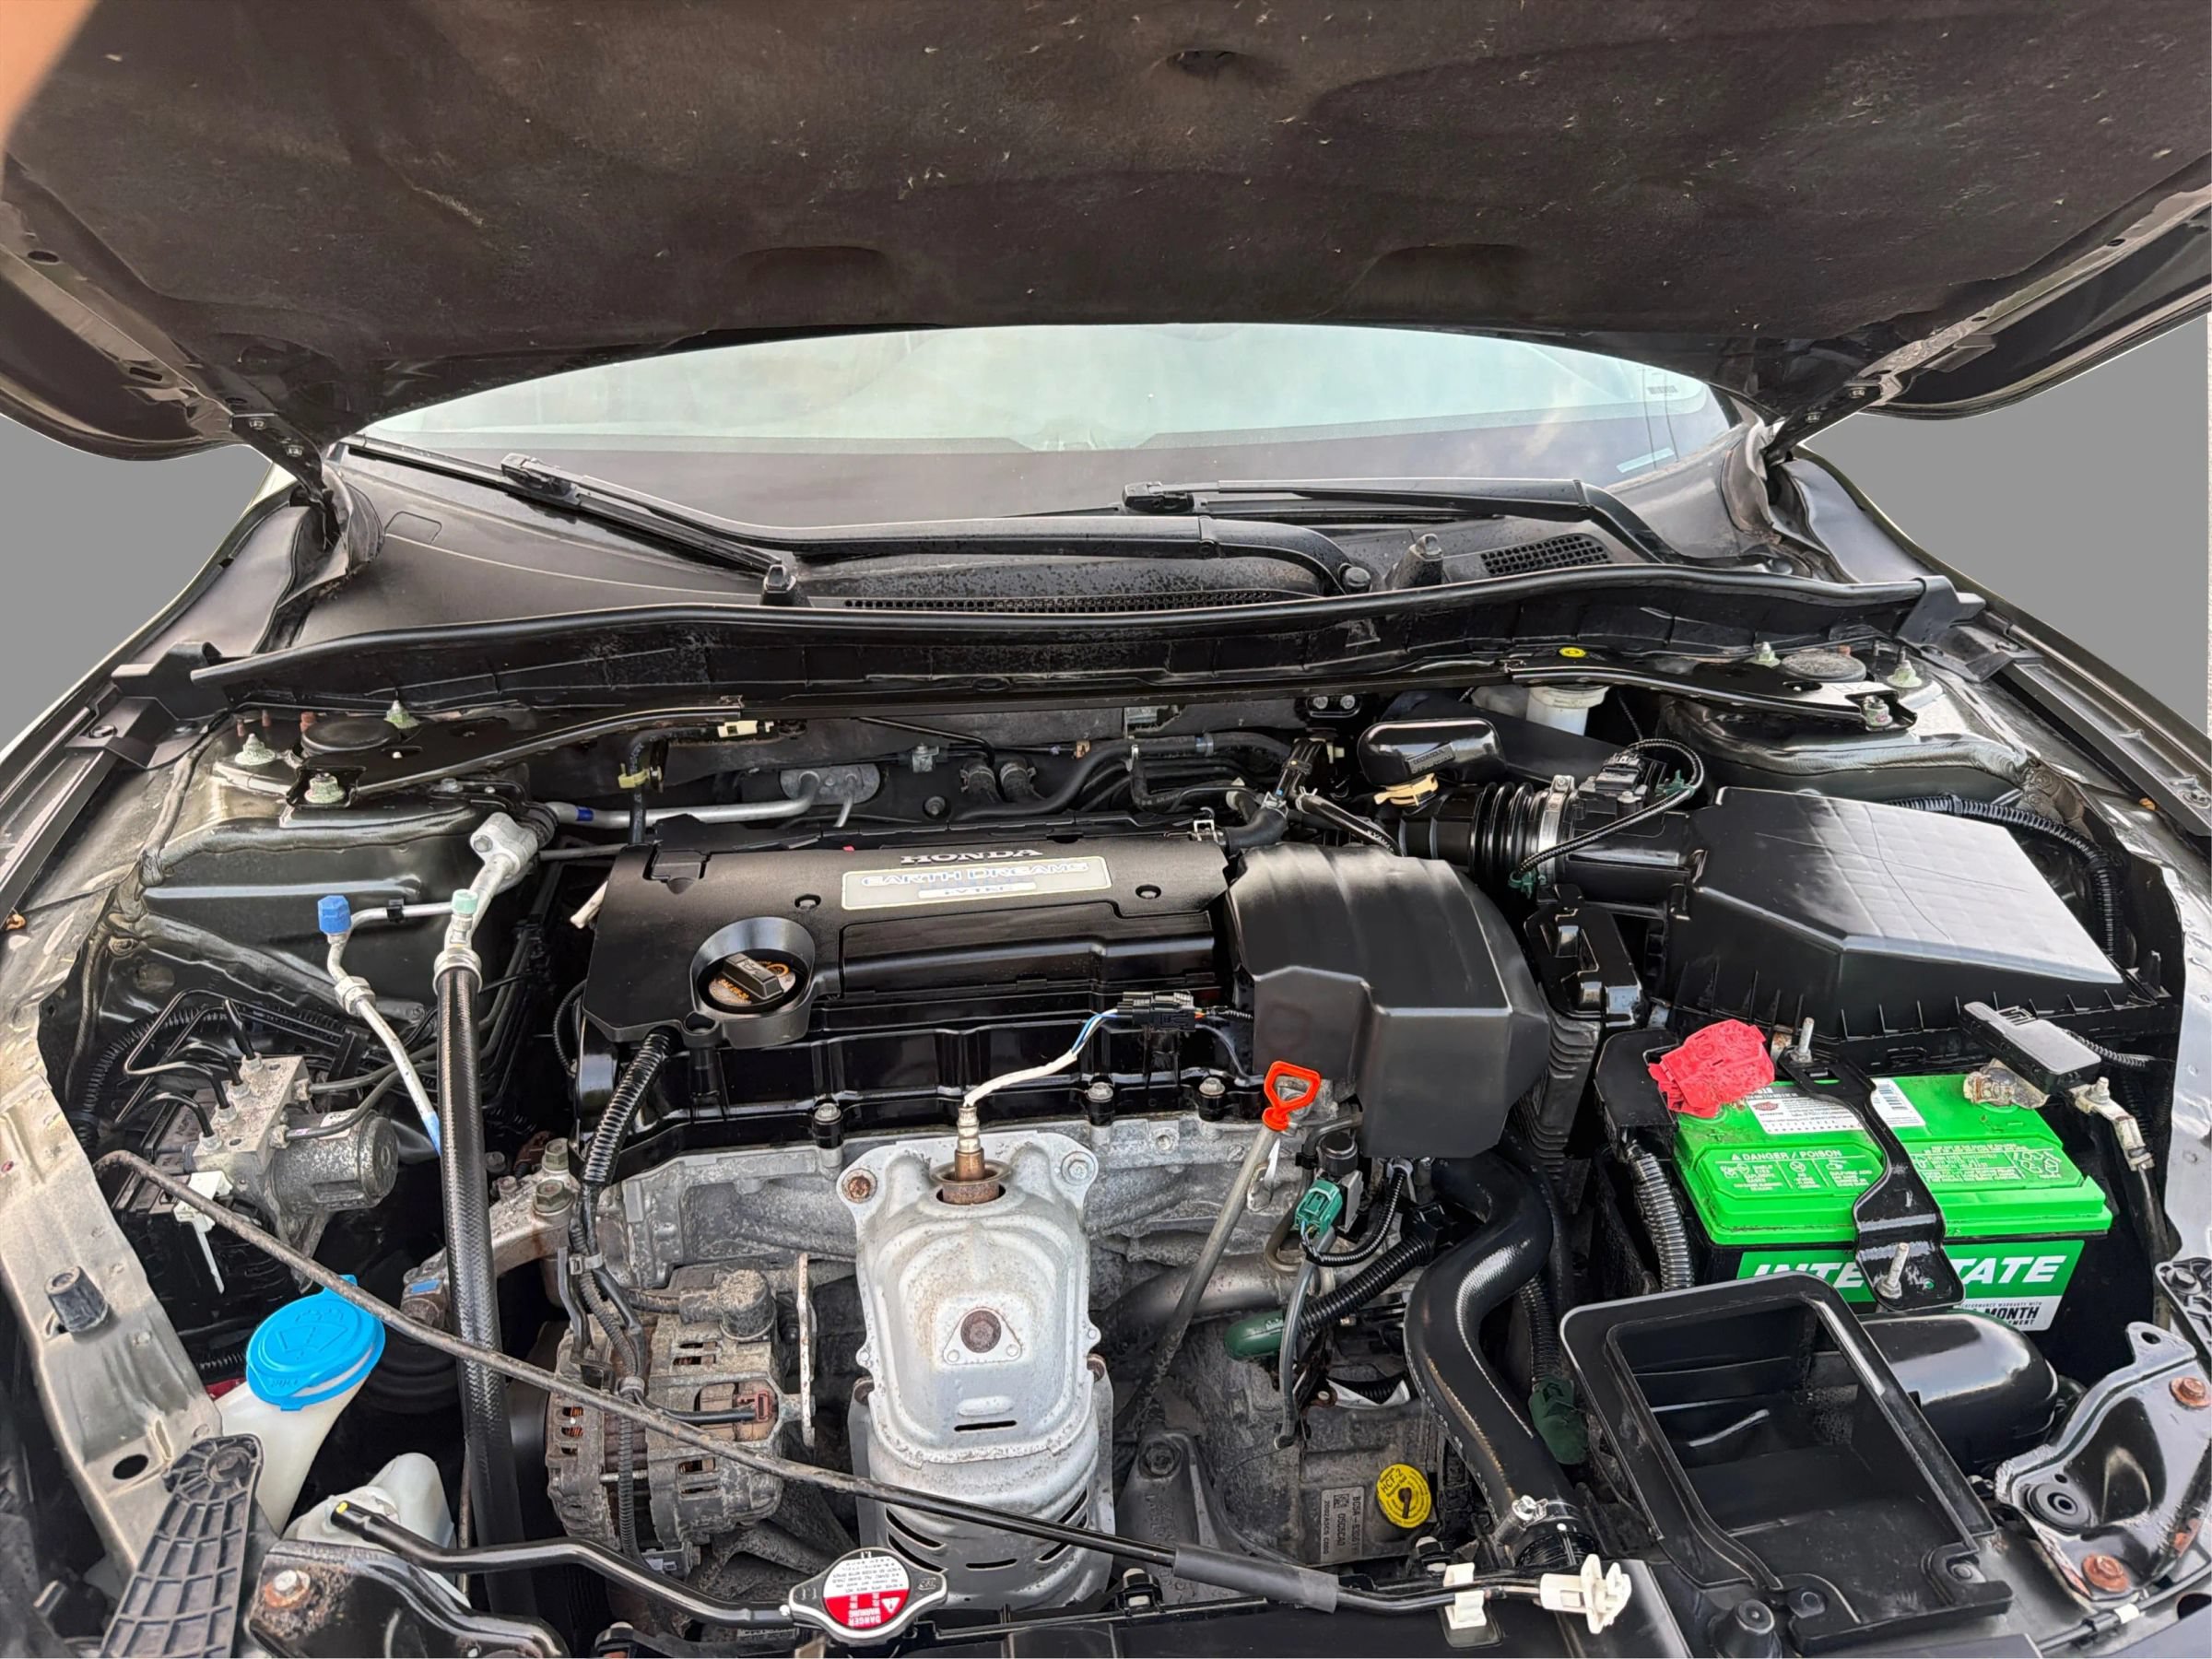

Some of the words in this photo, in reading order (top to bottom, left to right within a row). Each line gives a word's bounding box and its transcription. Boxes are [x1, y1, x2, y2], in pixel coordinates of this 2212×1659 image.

[900, 849, 1042, 865] HONDA
[861, 869, 962, 887] EARTH
[966, 862, 1090, 880] DREAMS
[1742, 1151, 1789, 1161] DANGER
[1799, 1149, 1842, 1159] POISON
[1754, 1254, 2067, 1288] ITETATE
[1984, 1306, 2041, 1320] MONTH
[1381, 1468, 1403, 1493] HCF-2
[848, 1615, 882, 1627] DANGER
